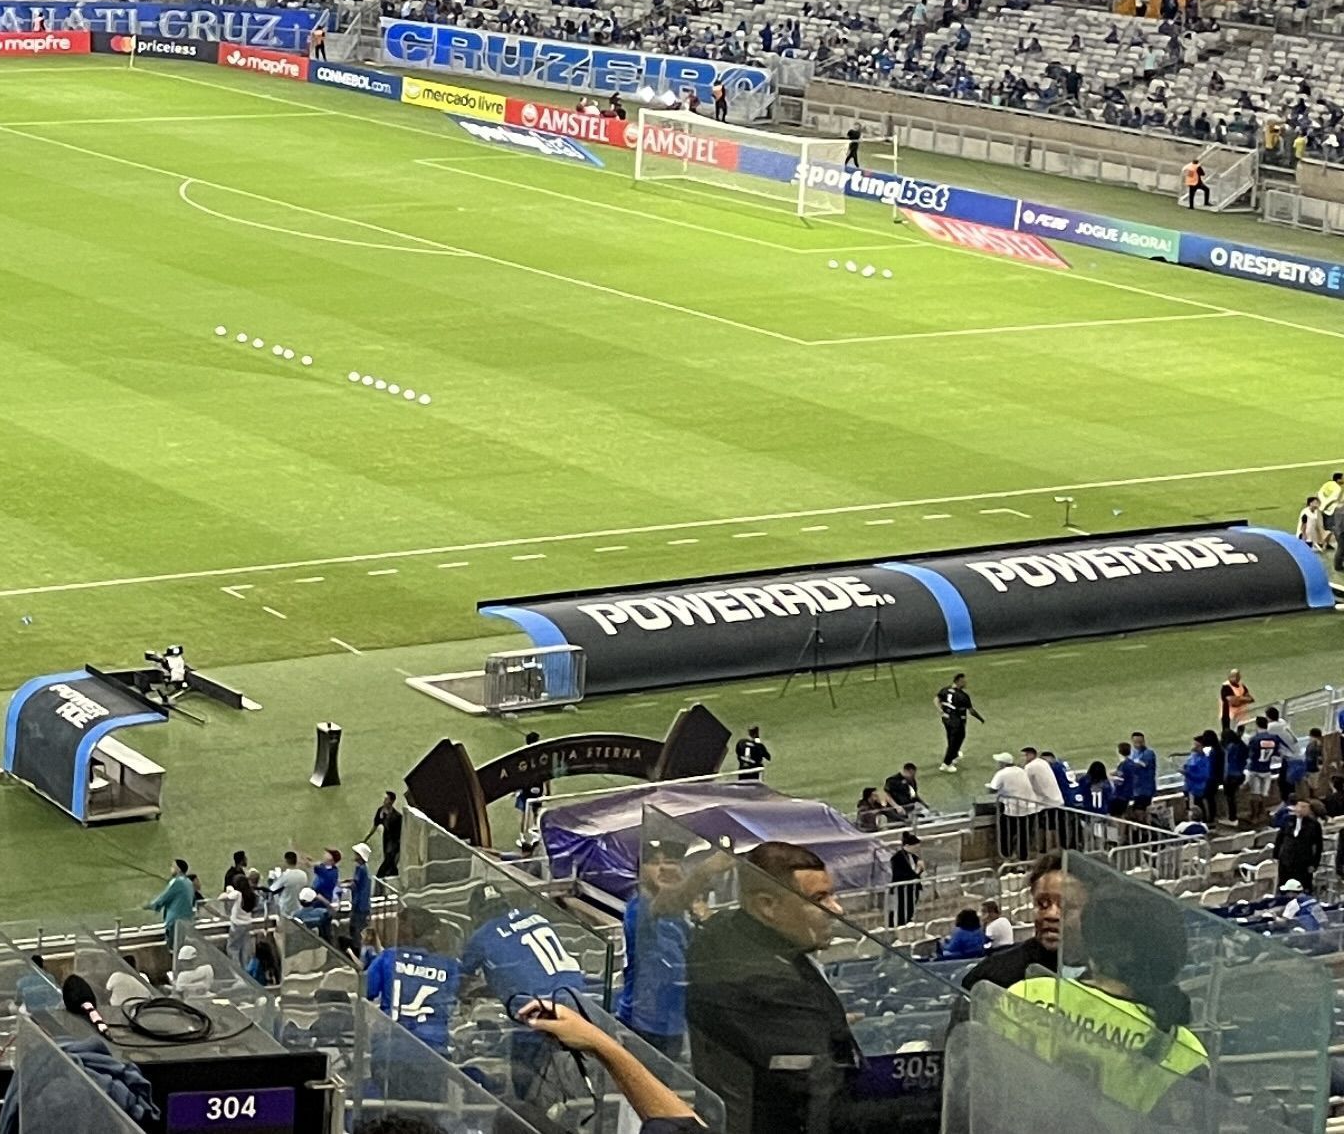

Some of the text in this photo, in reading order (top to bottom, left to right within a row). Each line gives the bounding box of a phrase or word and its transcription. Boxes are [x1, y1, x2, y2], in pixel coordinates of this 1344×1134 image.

[4, 34, 71, 53] mapfre
[137, 39, 197, 57] priceless
[248, 55, 300, 77] mapfre
[384, 21, 773, 106] CRUZEIRO
[422, 86, 505, 115] mercado livre
[539, 107, 610, 143] AMSTEL
[643, 125, 719, 165] AMSTEL
[792, 162, 950, 213] sportingbet
[1074, 222, 1172, 252] JOGUE AGORA!
[1210, 247, 1228, 266] O
[965, 537, 1249, 593] POWERADE
[577, 575, 879, 635] POWERADE
[49, 683, 110, 718] POWER
[500, 768, 509, 779] A
[587, 747, 642, 759] ETERNA
[1091, 791, 1103, 809] 11
[521, 926, 581, 976] 10
[392, 979, 439, 1023] 14
[892, 1056, 939, 1079] 305
[206, 1095, 257, 1120] 304
